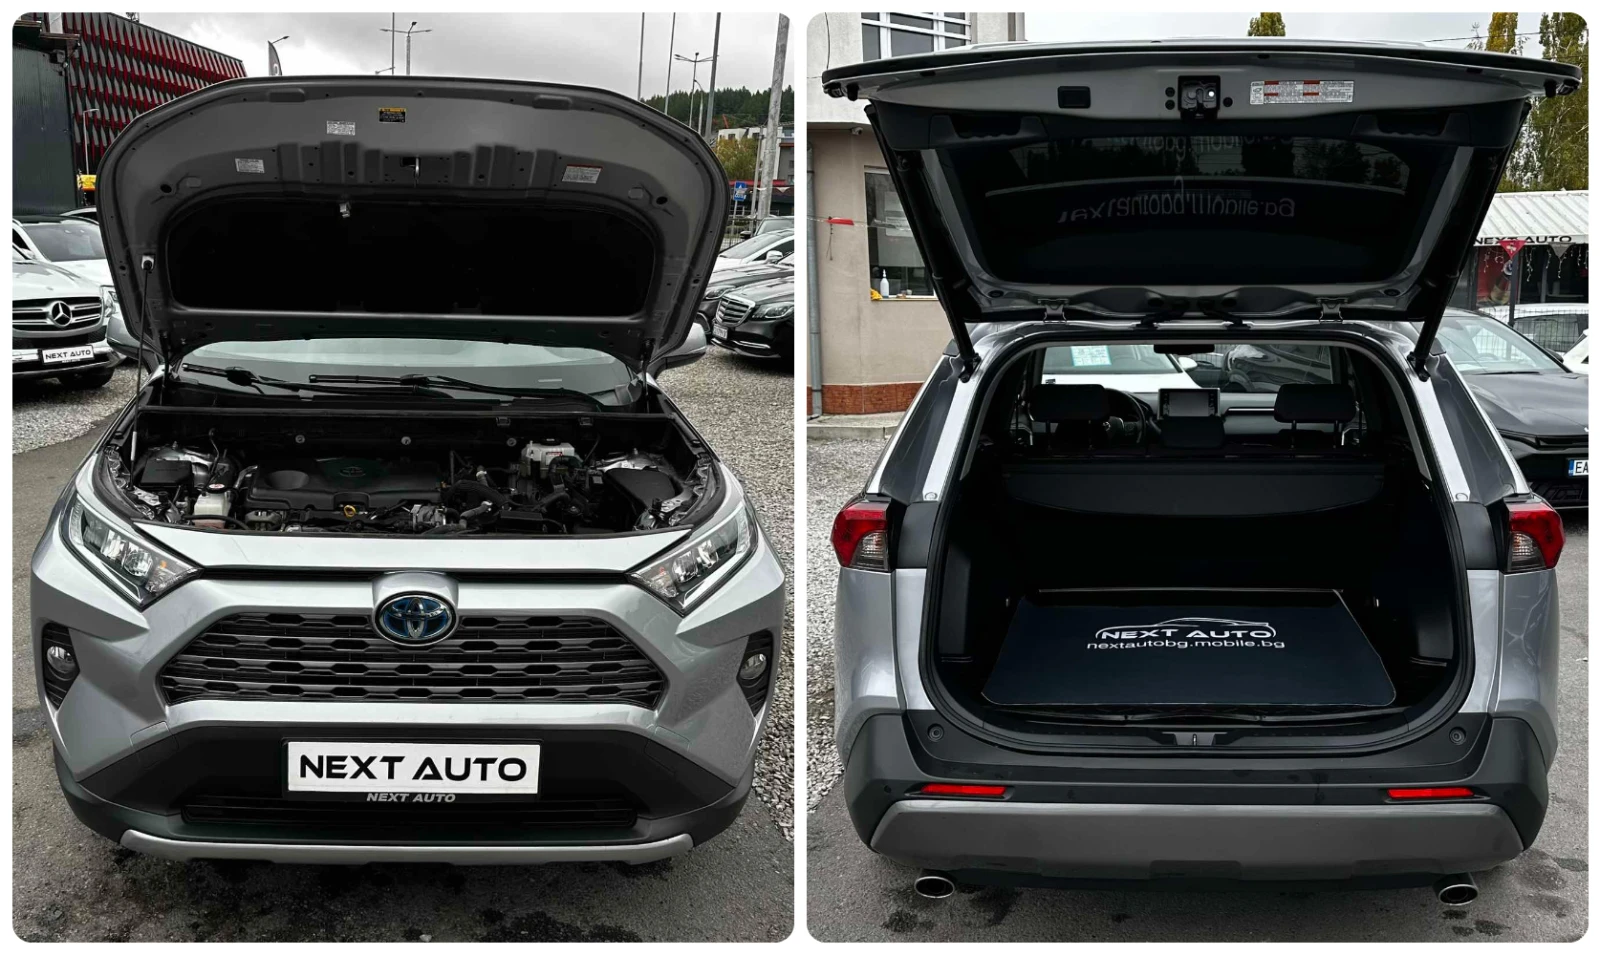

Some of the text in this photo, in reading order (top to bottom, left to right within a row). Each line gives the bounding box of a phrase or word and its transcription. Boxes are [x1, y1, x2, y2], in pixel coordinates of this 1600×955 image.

[1101, 629, 1272, 639] NEXT AUTO
[1087, 639, 1285, 649] nextautobg.mobile.bg
[300, 754, 527, 782] NEXT AUTO
[366, 792, 456, 803] NEXT AUTO
